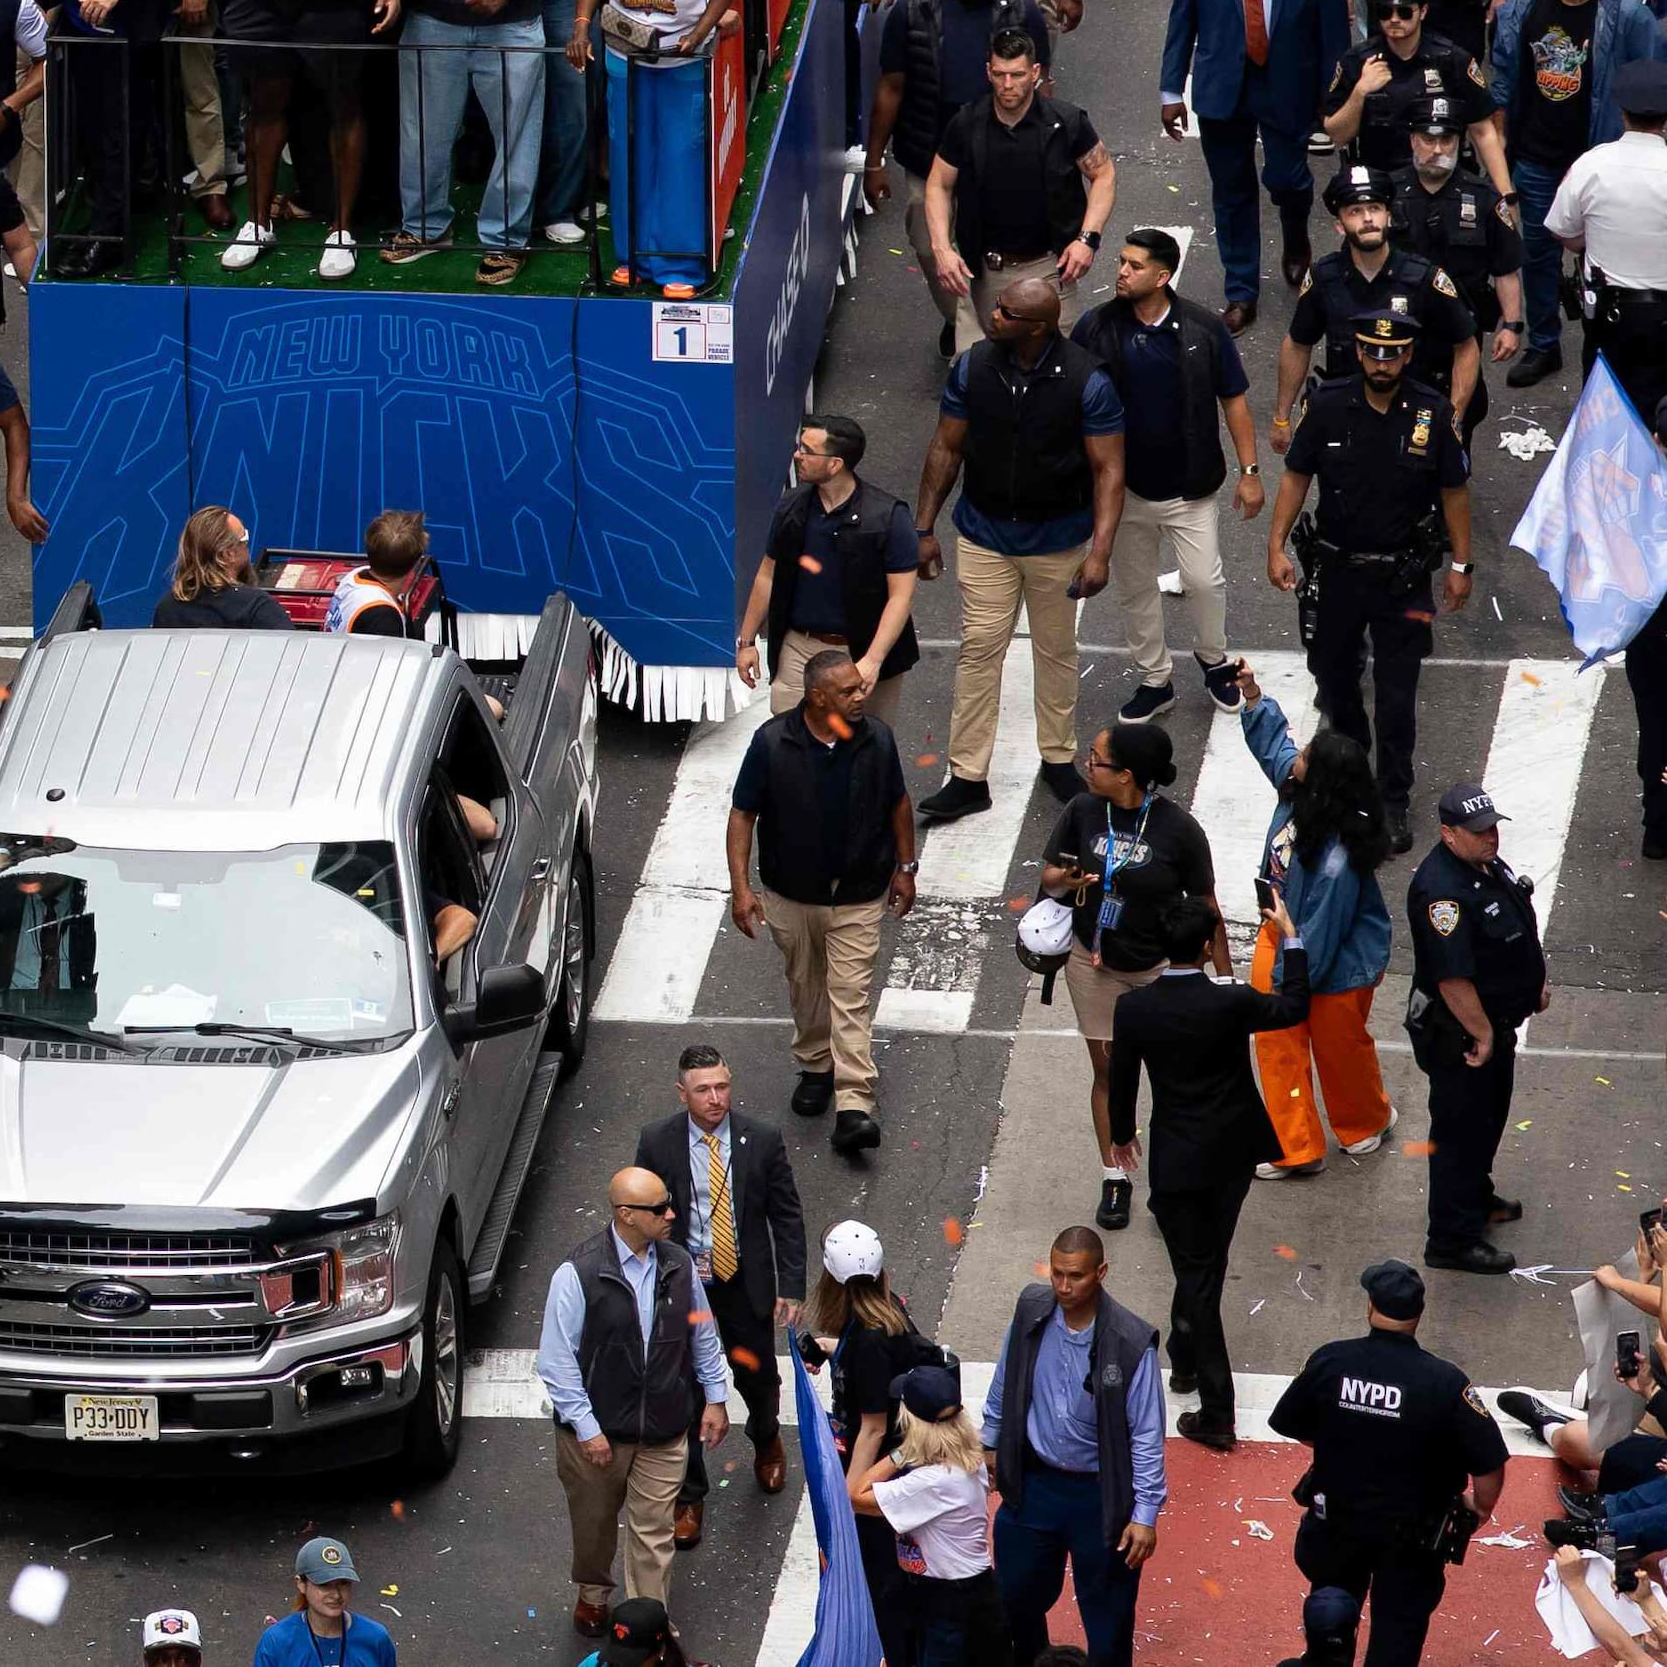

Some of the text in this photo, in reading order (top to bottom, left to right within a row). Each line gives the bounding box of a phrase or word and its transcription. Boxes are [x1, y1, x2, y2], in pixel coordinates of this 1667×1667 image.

[766, 226, 799, 399] CHASE
[228, 314, 541, 398] NEW YORK
[673, 326, 687, 356] 1
[33, 386, 737, 659] KNICKS
[1093, 836, 1149, 864] KICKS
[88, 1293, 130, 1309] Ford
[88, 1397, 136, 1409] New Jersey
[1340, 1376, 1402, 1411] NYPD
[88, 1430, 136, 1438] Garden State
